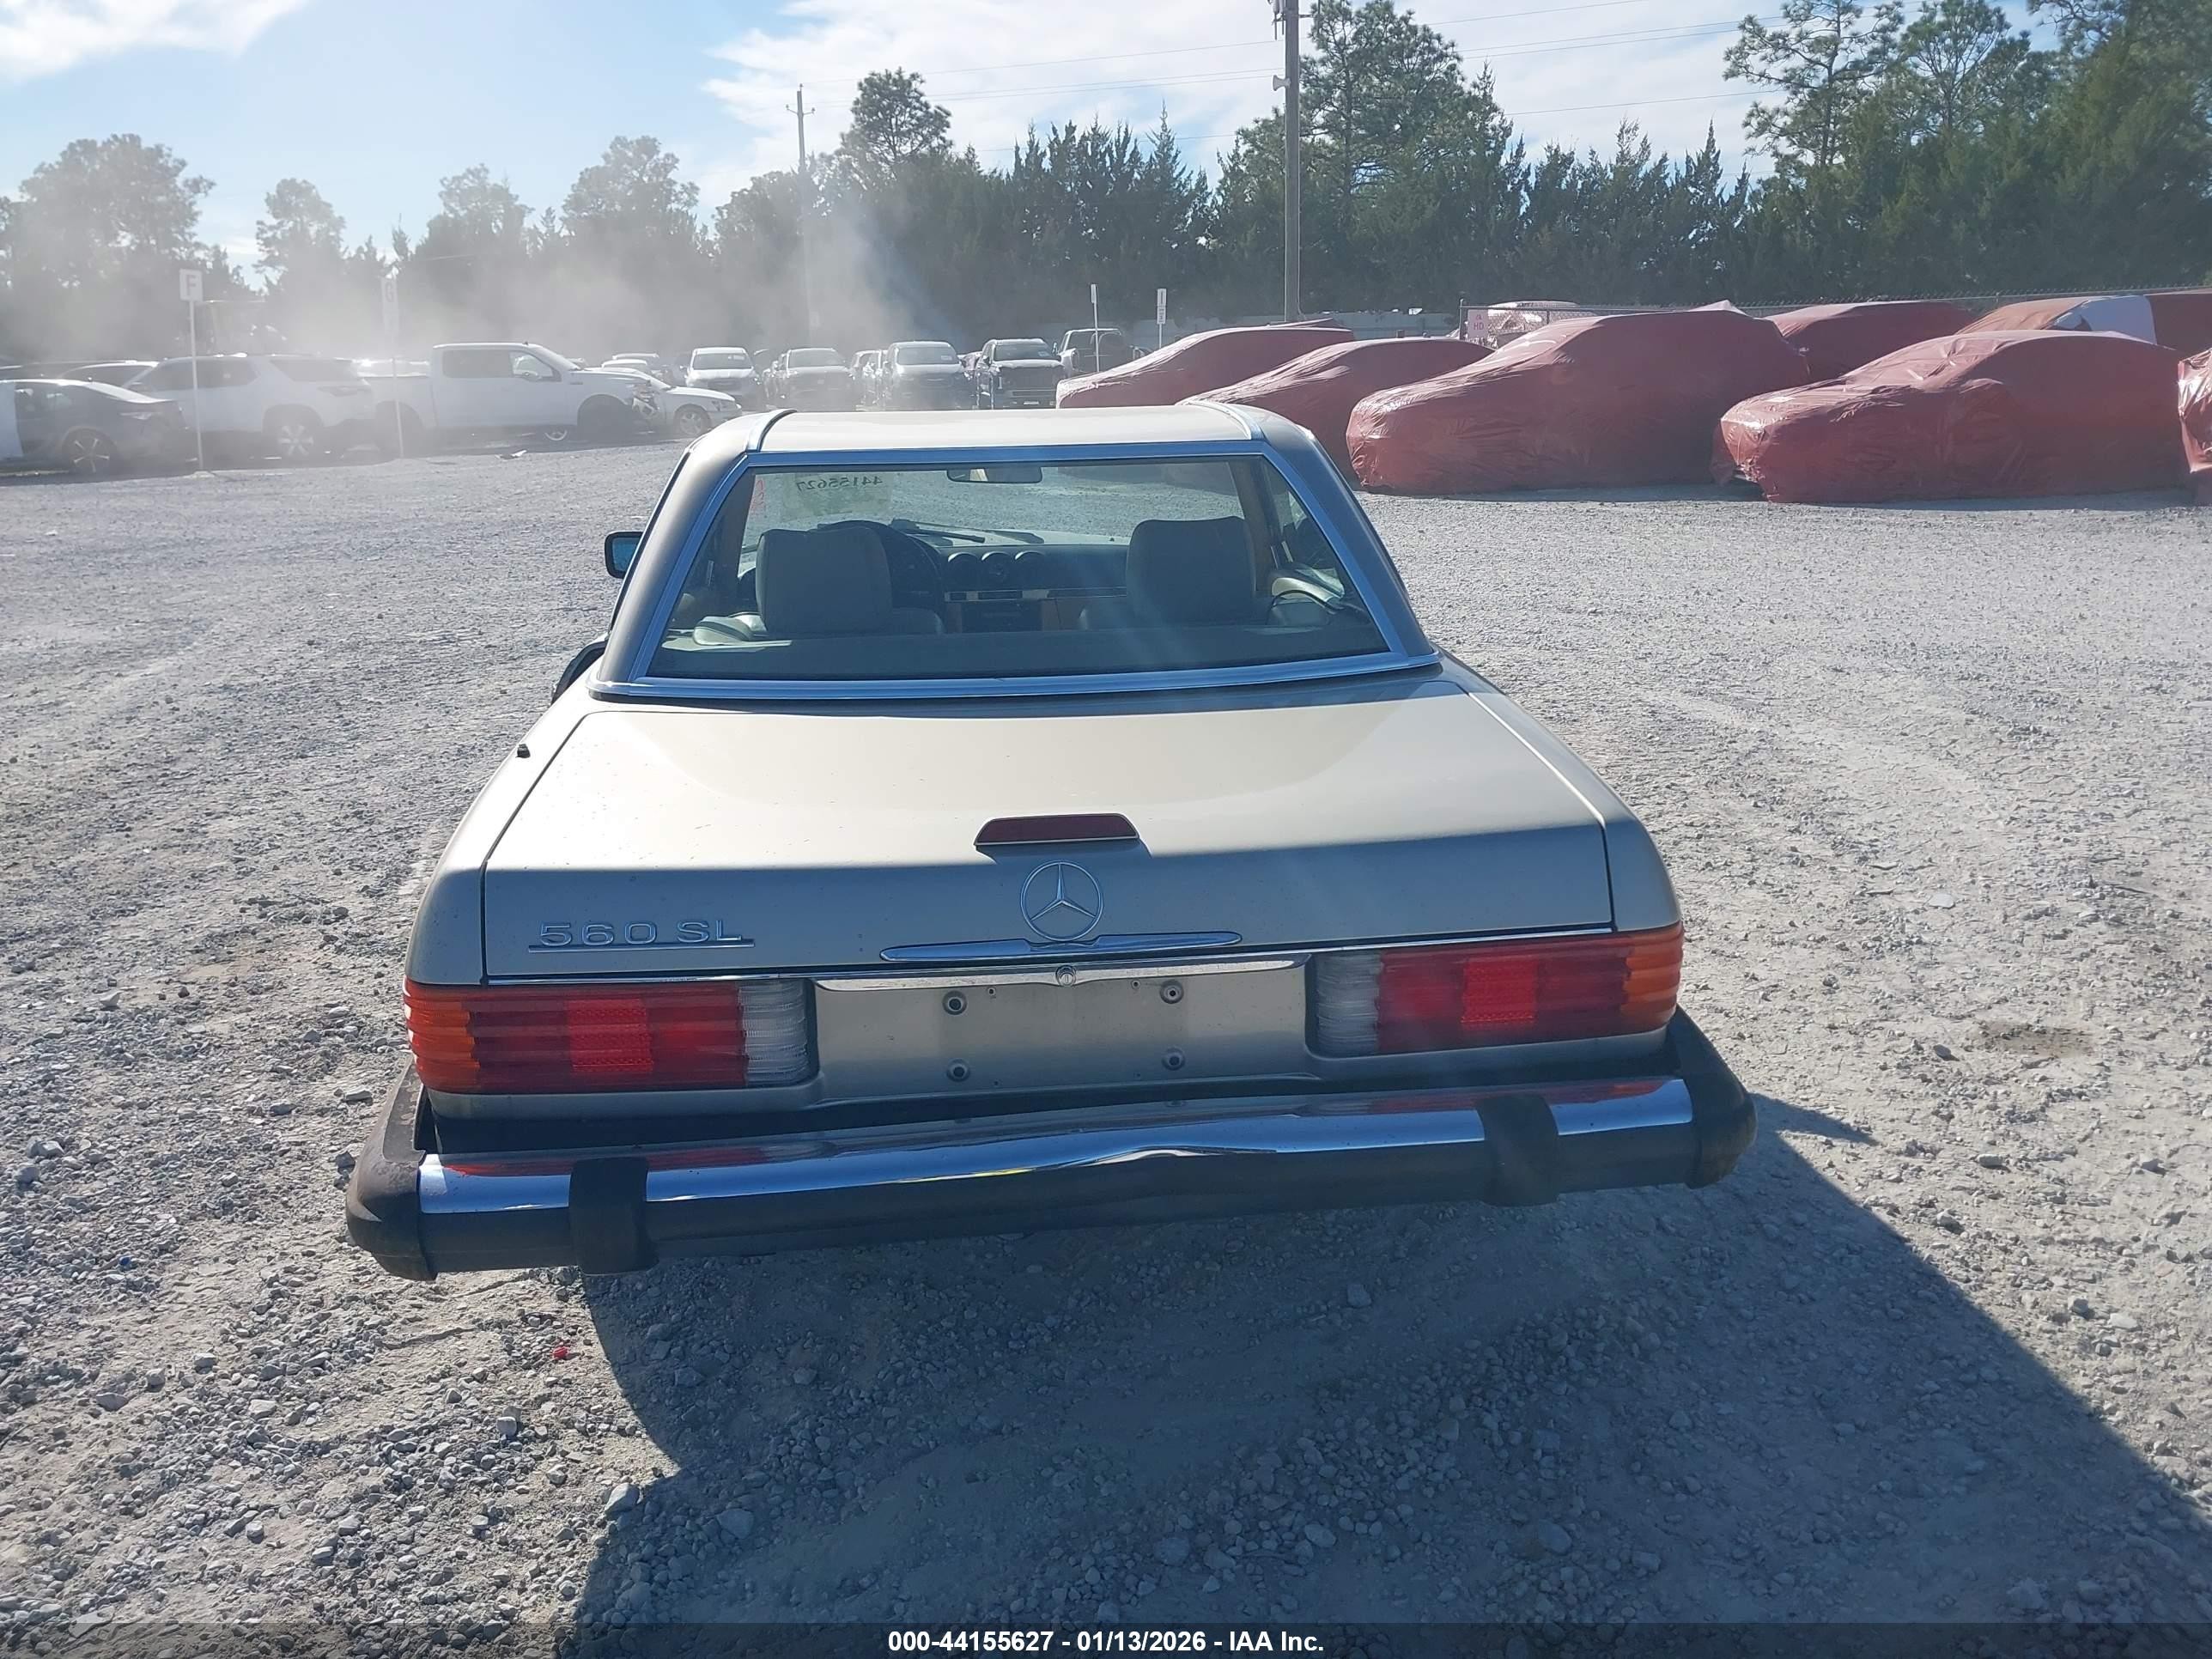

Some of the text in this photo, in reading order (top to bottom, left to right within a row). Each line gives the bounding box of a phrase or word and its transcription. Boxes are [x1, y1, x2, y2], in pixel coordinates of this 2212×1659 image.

[186, 274, 197, 296] F
[538, 920, 743, 946] 560 SL
